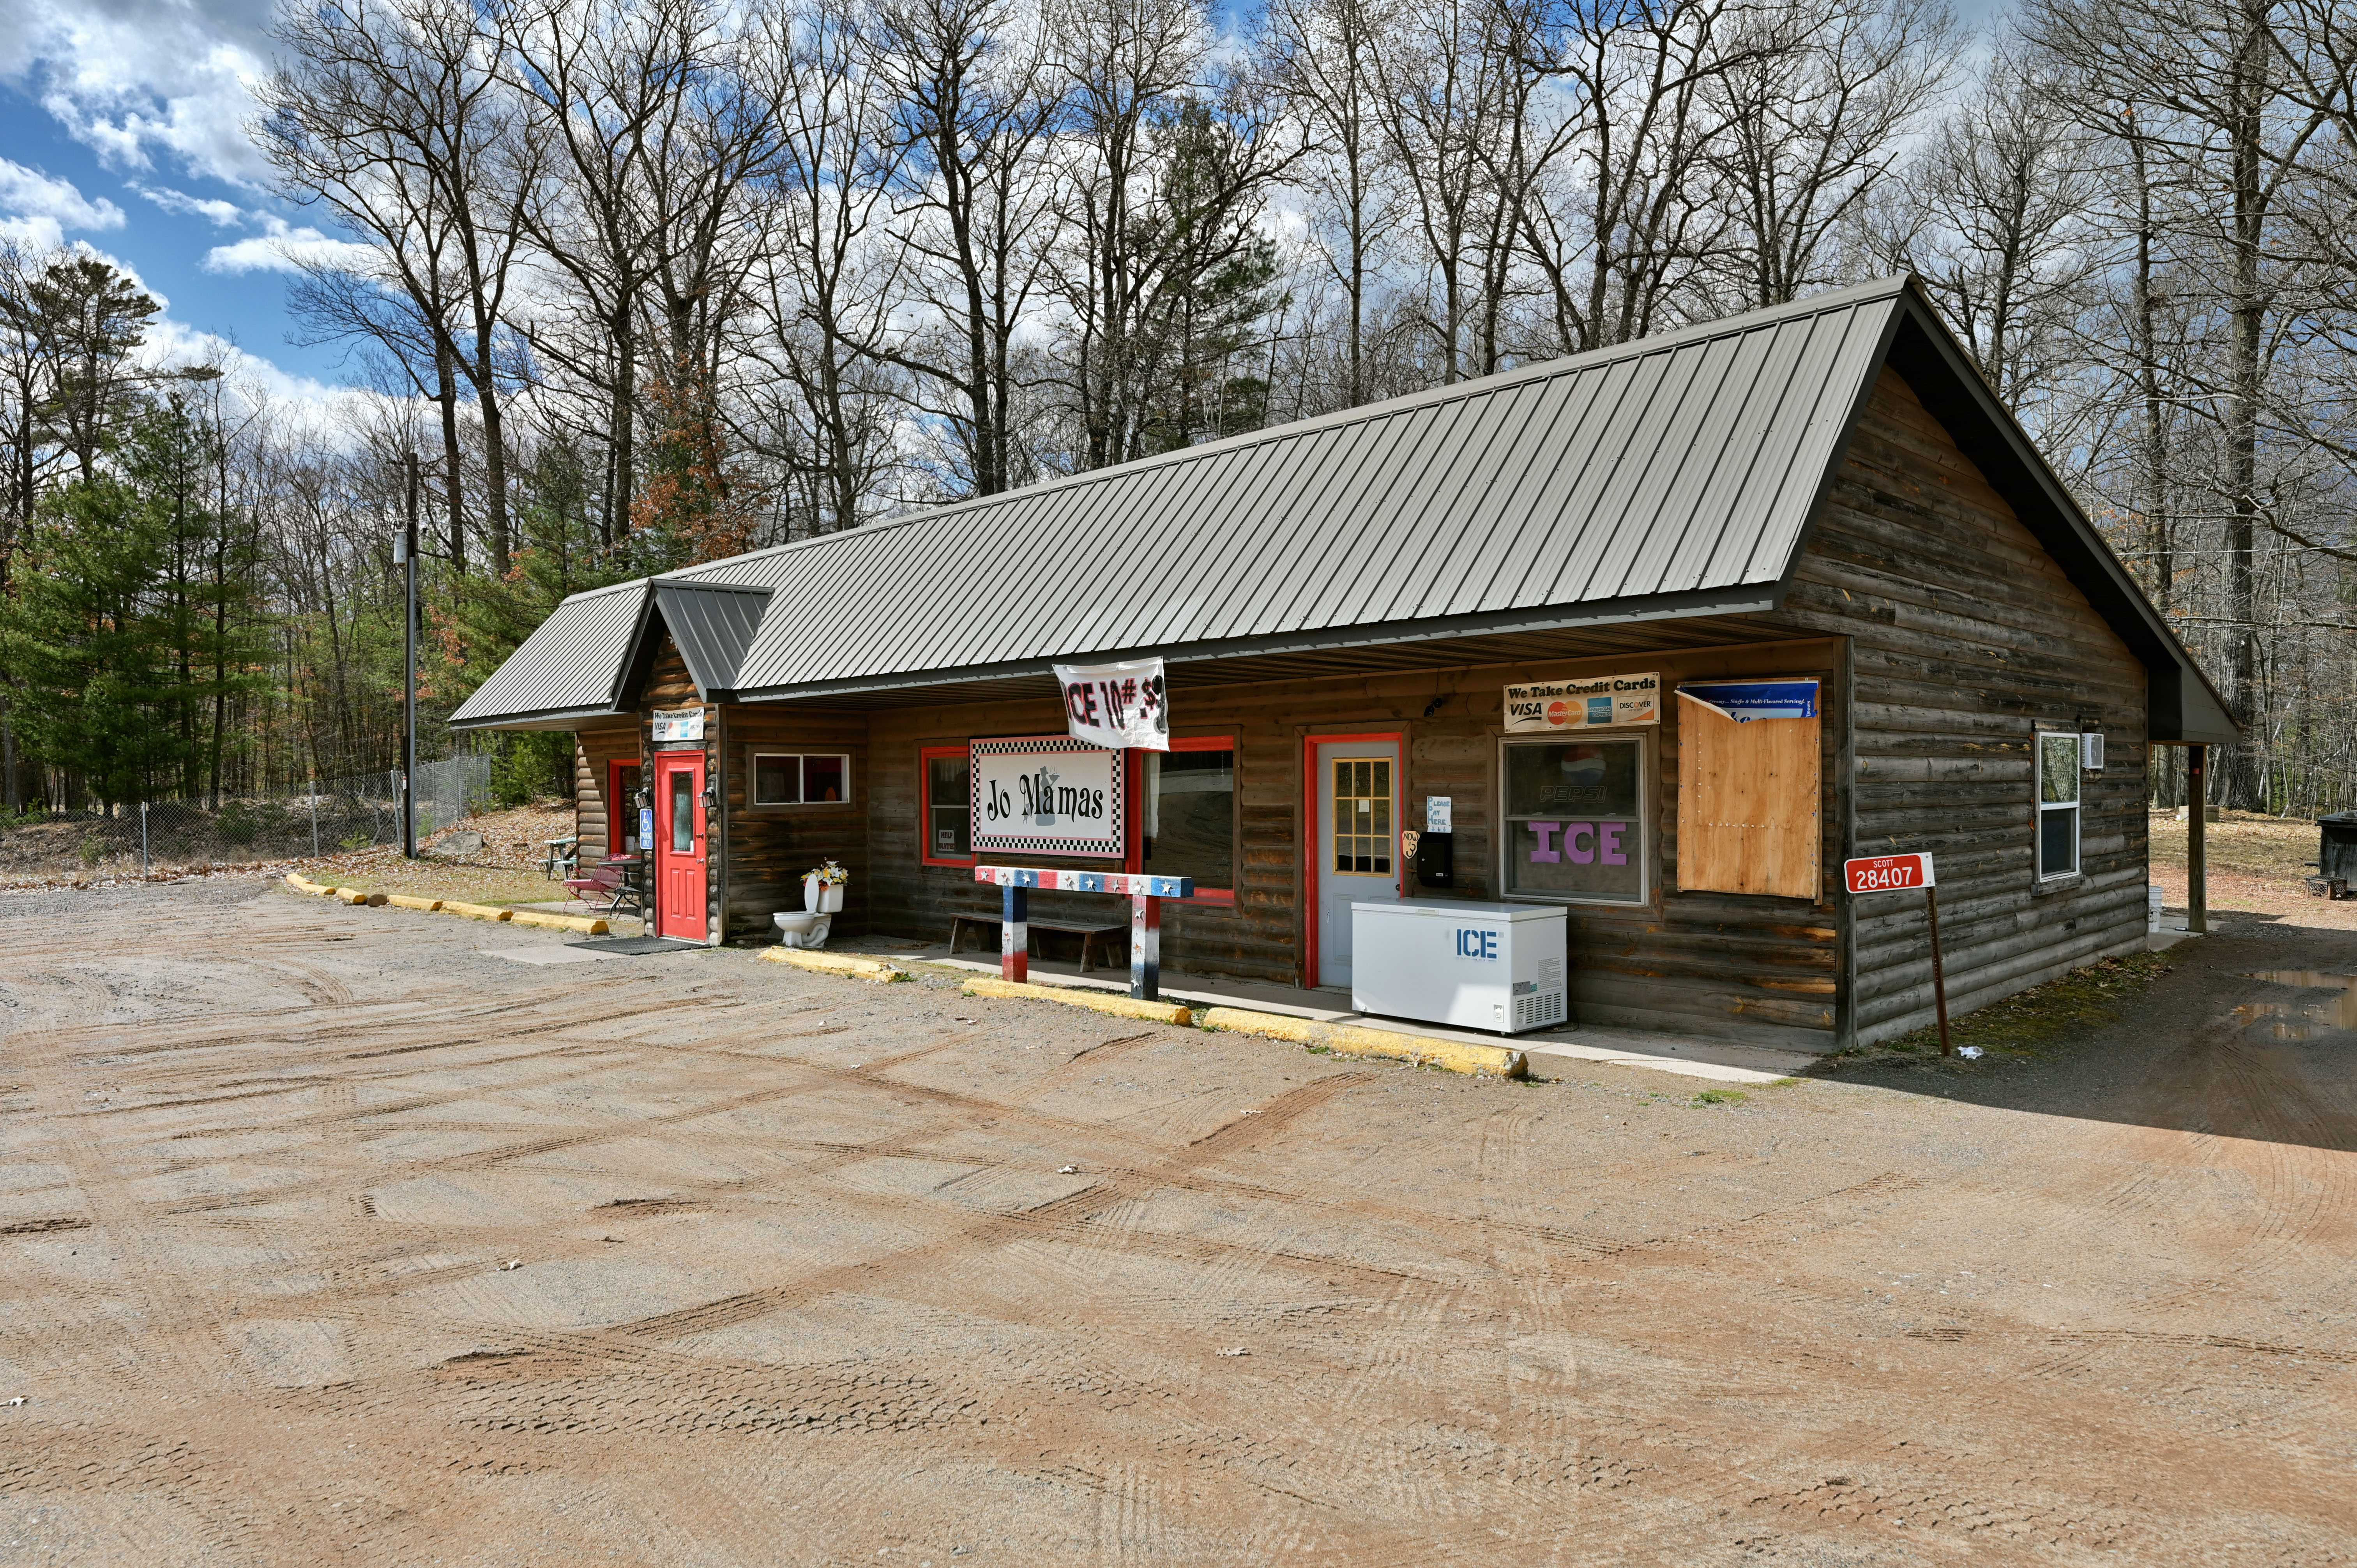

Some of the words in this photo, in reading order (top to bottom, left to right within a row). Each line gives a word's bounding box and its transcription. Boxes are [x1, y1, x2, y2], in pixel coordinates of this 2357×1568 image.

[1508, 688, 1527, 699] We
[1530, 686, 1563, 697] Take
[1566, 682, 1610, 695] Credit
[1614, 678, 1656, 691] Cards
[1509, 703, 1542, 716] VISA
[987, 779, 1011, 821] Jo
[1019, 773, 1103, 823] Mamas
[1540, 786, 1608, 803] PEPSI
[1428, 806, 1440, 816] PAY
[1428, 815, 1447, 825] HERE
[1403, 832, 1419, 841] NOW
[1528, 821, 1627, 865] ICE
[1873, 859, 1893, 868] SCOTT
[1856, 866, 1912, 889] 28407
[1457, 929, 1497, 959] ICE
